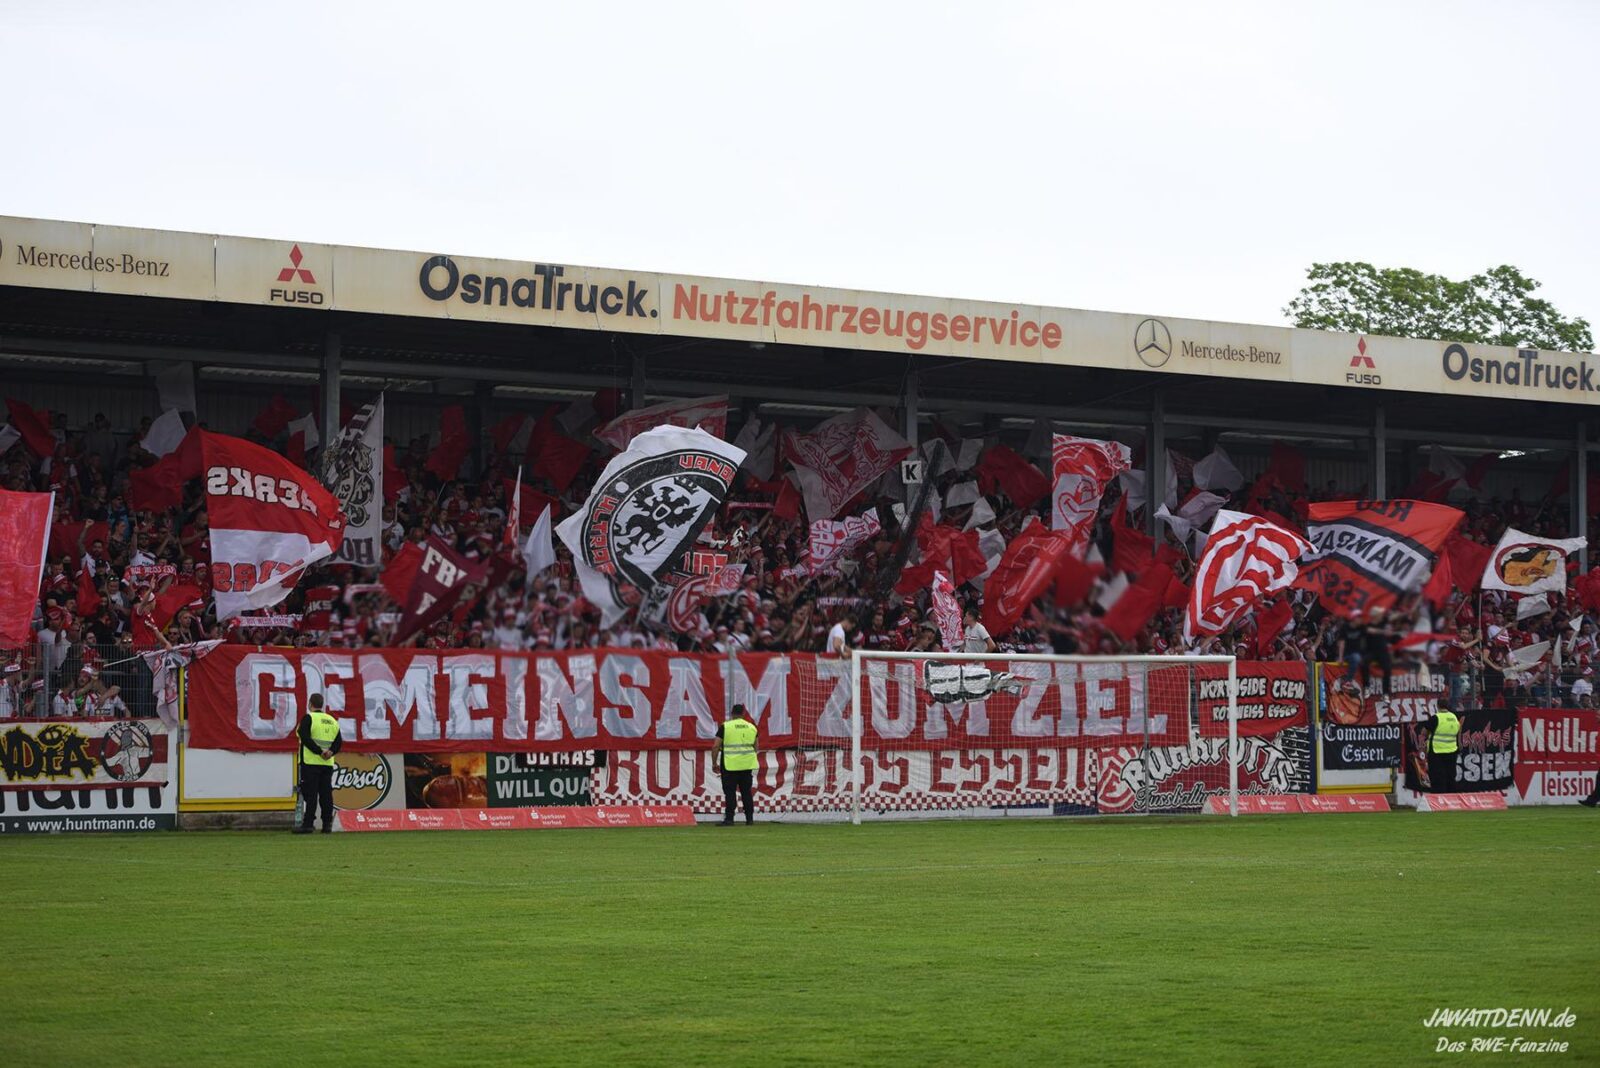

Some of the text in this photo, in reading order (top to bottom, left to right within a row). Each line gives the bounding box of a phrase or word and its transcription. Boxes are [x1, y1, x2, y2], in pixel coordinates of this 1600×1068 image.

[17, 244, 170, 278] Mercedes-Benz
[270, 289, 323, 305] FUSO
[419, 255, 1062, 350] OsnaTruck. Nutzfahrzeugservice
[1181, 340, 1281, 365] Mercedes-Benz
[1346, 373, 1381, 385] FUSO
[905, 464, 917, 481] K
[235, 652, 792, 741] GEMEINSAM
[1009, 660, 1168, 738] ZIEL
[1324, 722, 1401, 742] Commando
[1342, 744, 1384, 762] Essen
[1455, 750, 1512, 782] SSEN
[496, 779, 544, 799] WILL
[27, 816, 156, 832] www.huntmann.de
